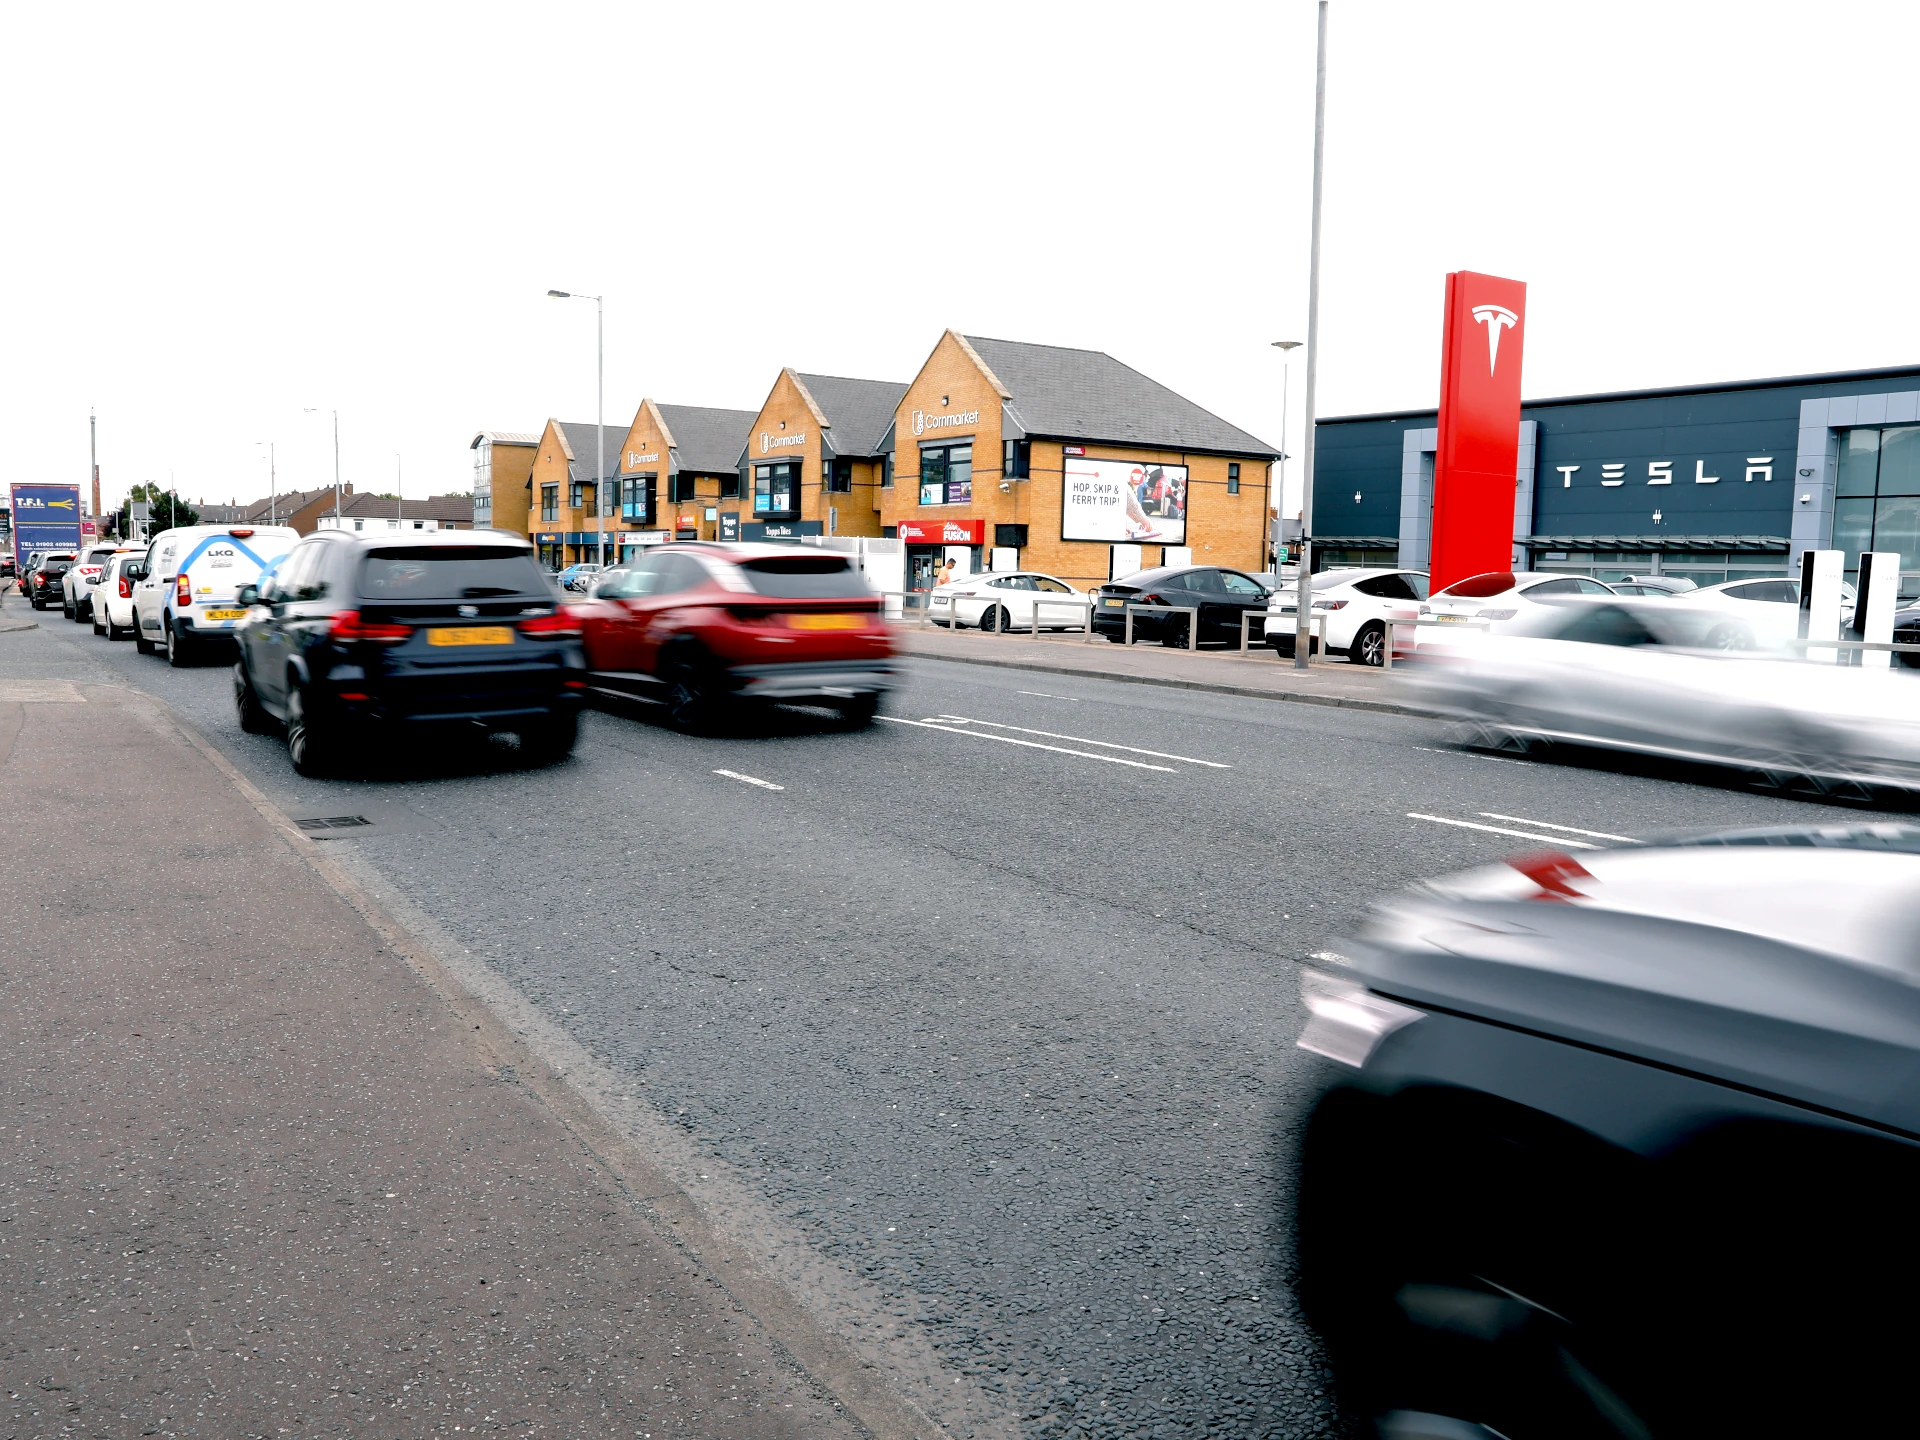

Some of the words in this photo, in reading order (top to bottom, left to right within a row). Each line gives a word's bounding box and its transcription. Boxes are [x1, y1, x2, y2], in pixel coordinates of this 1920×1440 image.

[925, 410, 979, 429] Cornmarket
[769, 432, 806, 449] Cornmarket
[1556, 457, 1775, 488] TESLA
[1093, 483, 1112, 494] SKIP
[1113, 485, 1119, 494] &
[1072, 495, 1097, 505] FERRY
[1099, 496, 1120, 506] TRIP!
[722, 516, 736, 526] Topps
[724, 527, 734, 536] Tiles
[765, 526, 780, 536] Topps
[780, 526, 792, 535] Tiles
